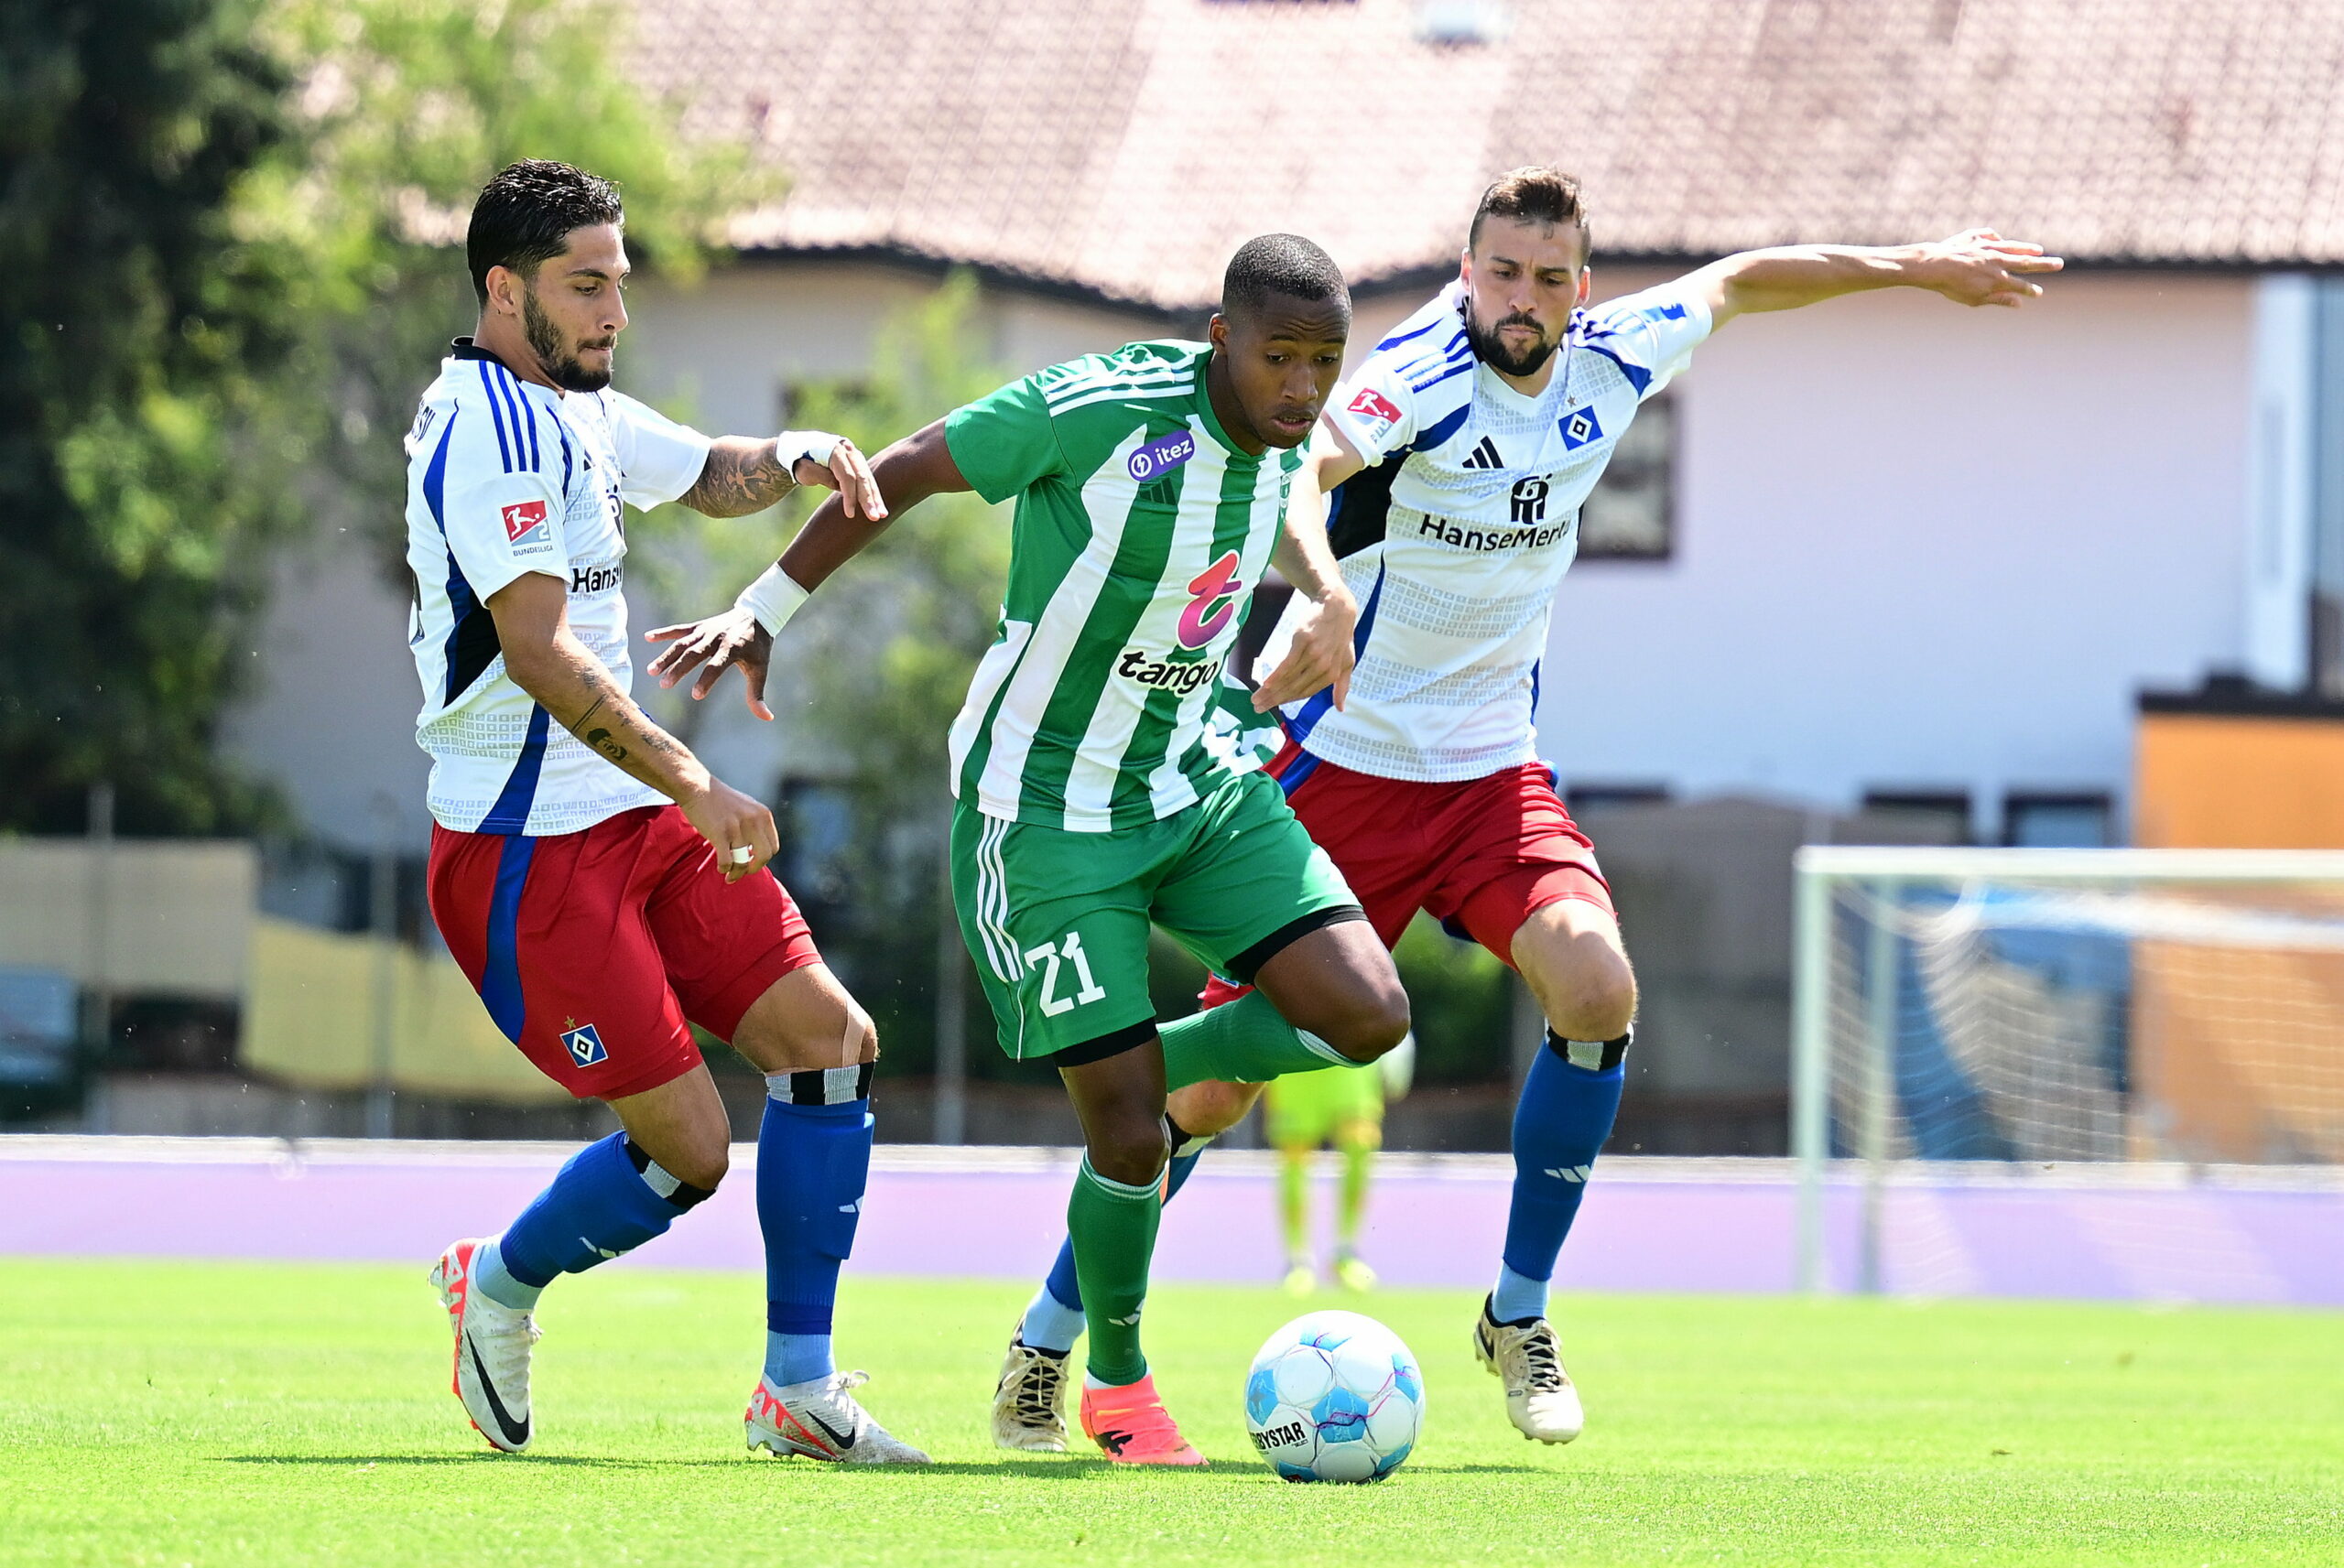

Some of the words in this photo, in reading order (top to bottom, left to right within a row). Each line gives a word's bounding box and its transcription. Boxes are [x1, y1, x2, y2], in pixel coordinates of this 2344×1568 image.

[1155, 439, 1192, 466] itez
[1119, 651, 1218, 695] tango
[1024, 931, 1106, 1018] 21
